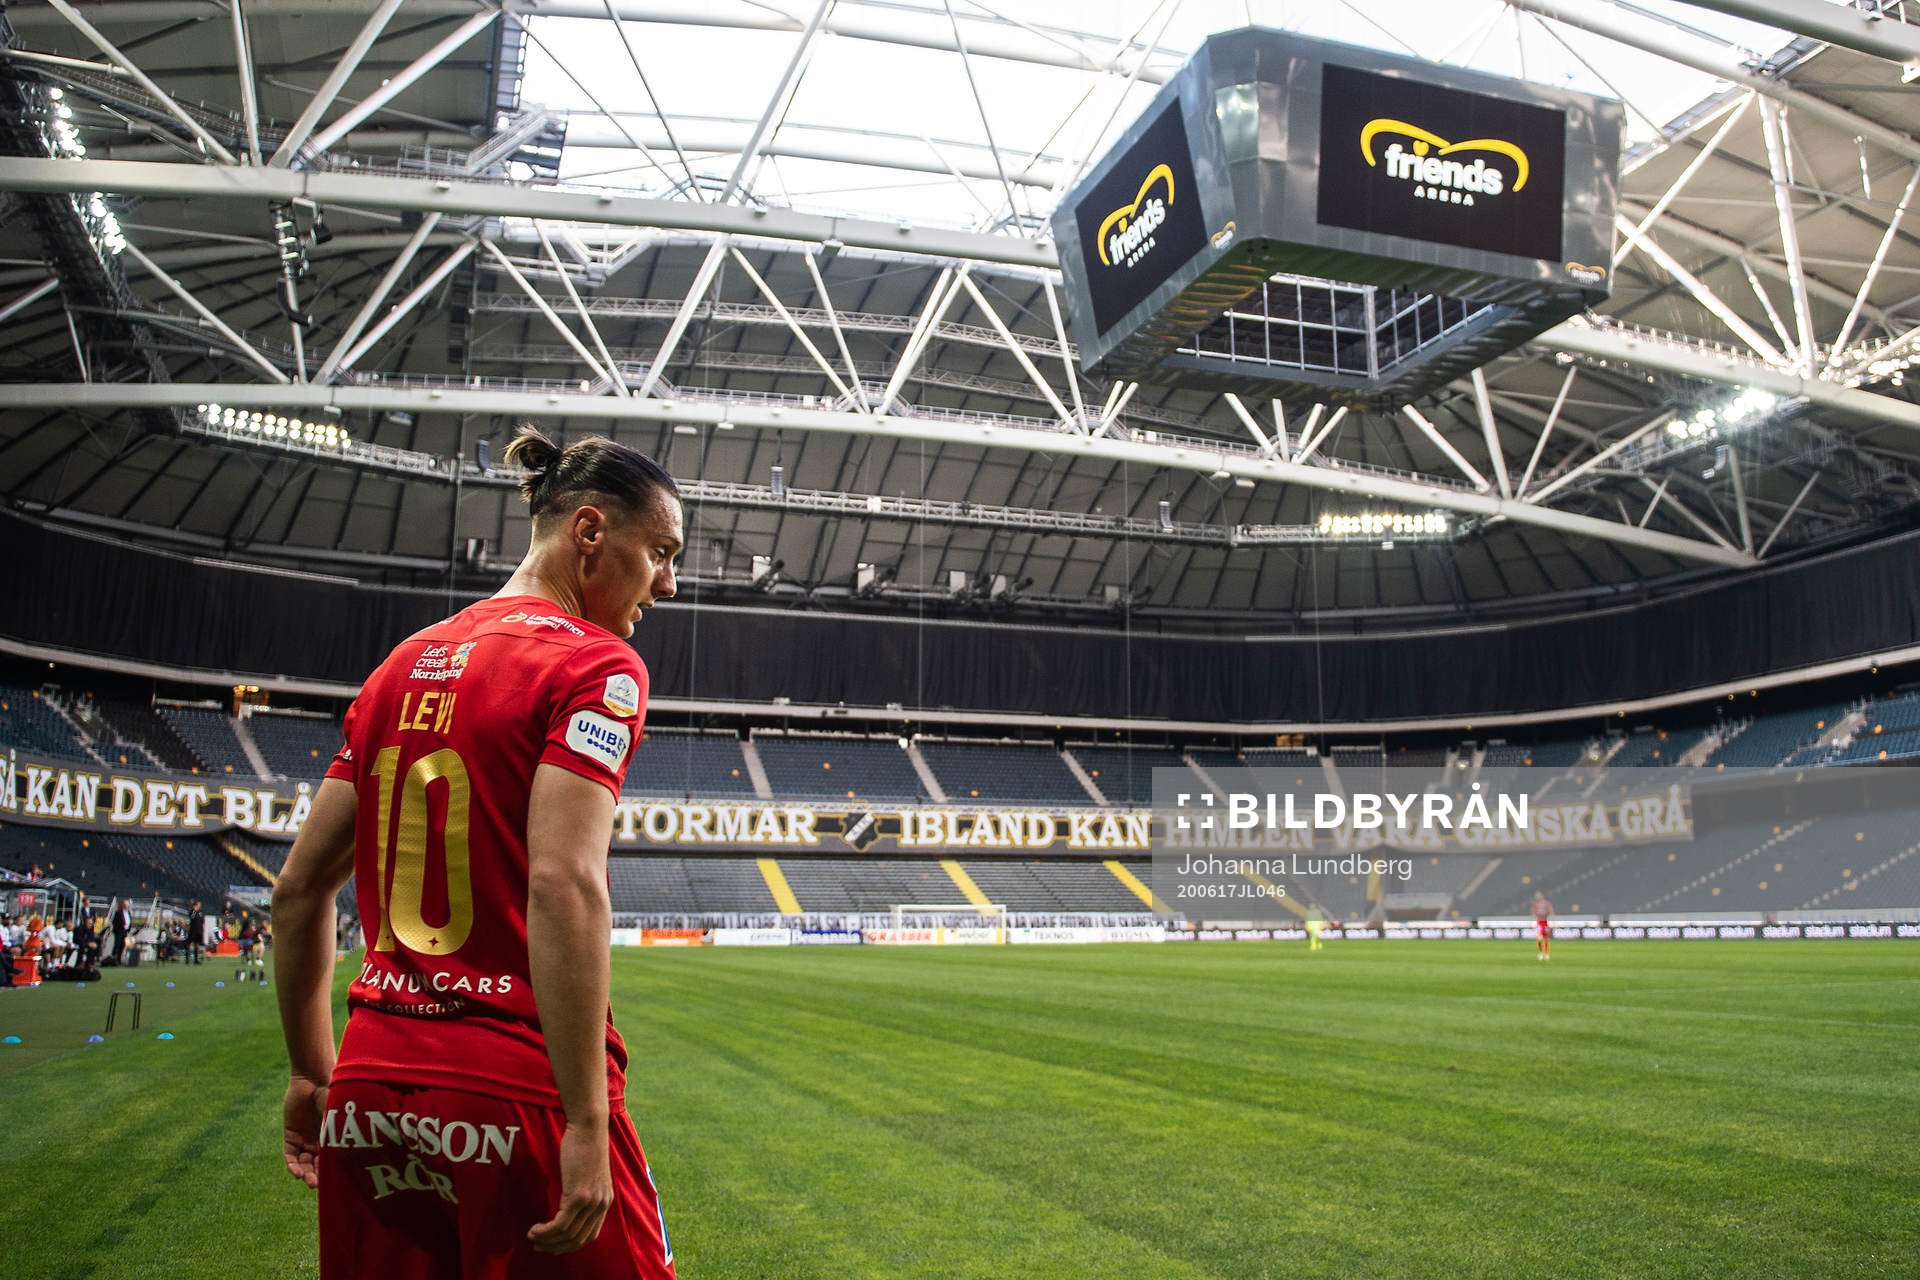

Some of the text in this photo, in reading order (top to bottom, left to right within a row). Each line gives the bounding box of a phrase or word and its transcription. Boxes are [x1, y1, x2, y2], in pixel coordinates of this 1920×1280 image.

[1385, 140, 1504, 195] friends
[1413, 185, 1475, 207] ARENA
[1109, 198, 1166, 266] friends
[398, 691, 457, 735] LEVI
[25, 767, 100, 819] KAN
[110, 777, 208, 826] DET
[900, 810, 1055, 847] IBLAND
[1068, 812, 1152, 848] KAN
[1618, 784, 1688, 838] GRÅ
[370, 745, 474, 956] 10
[432, 971, 513, 994] CARS
